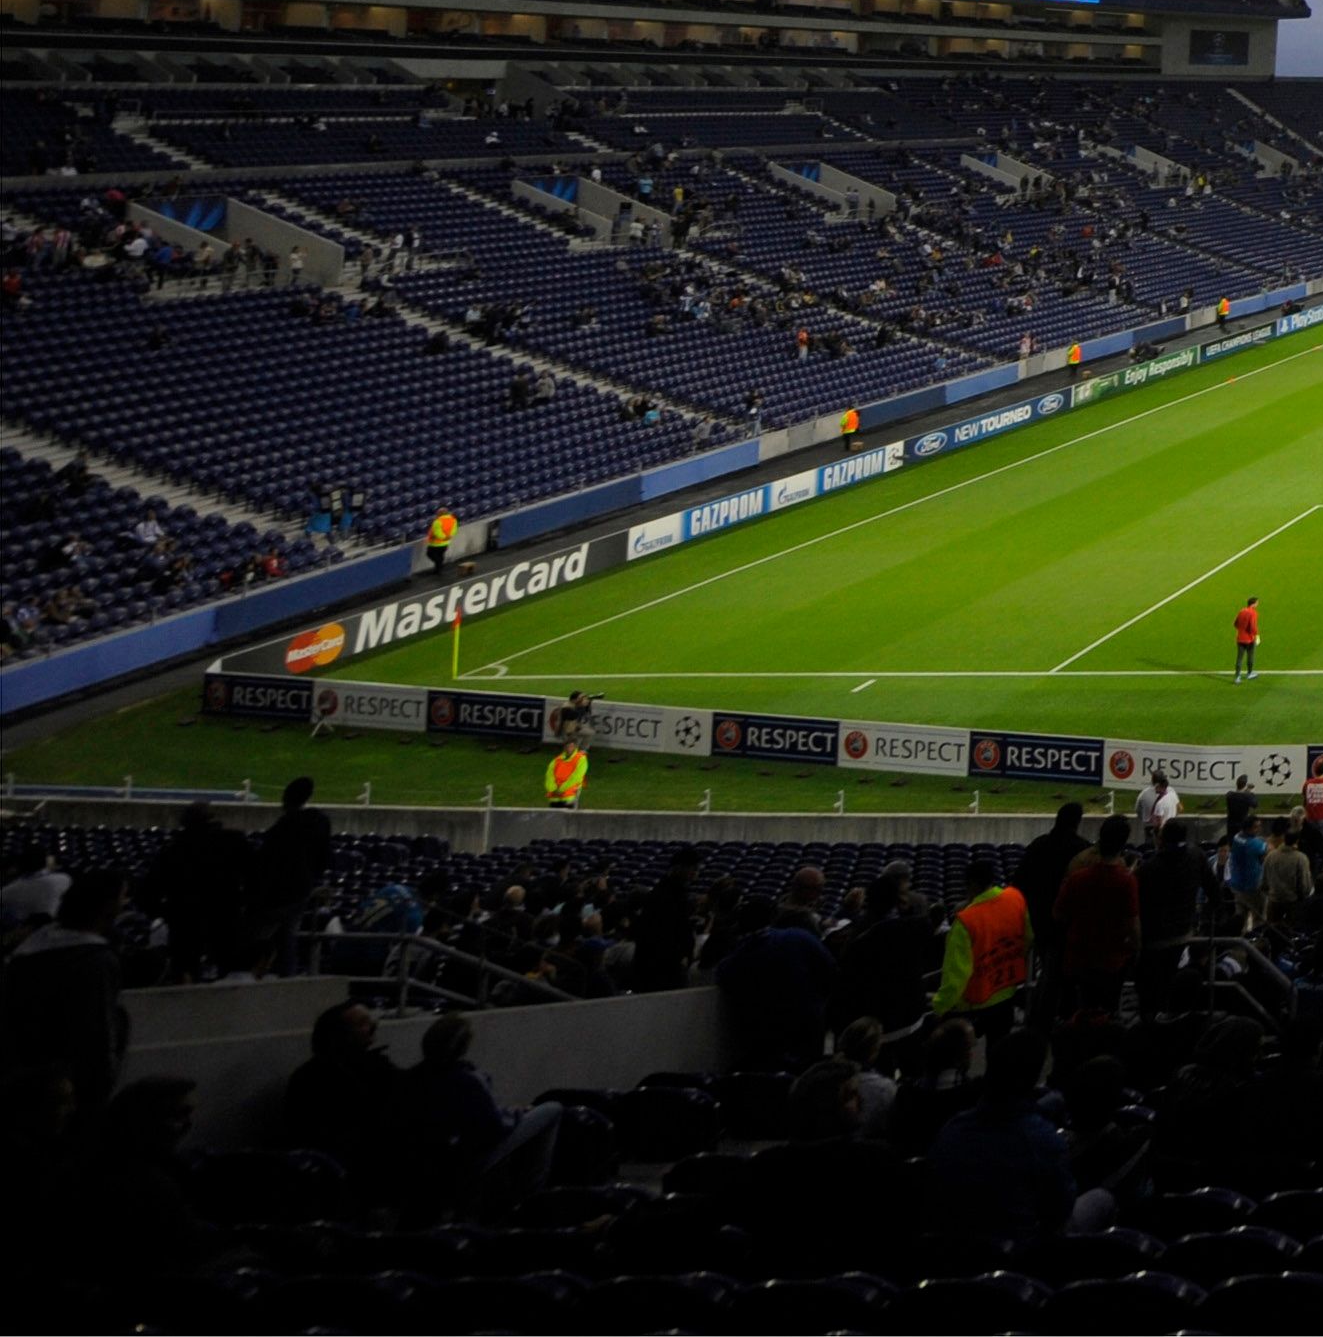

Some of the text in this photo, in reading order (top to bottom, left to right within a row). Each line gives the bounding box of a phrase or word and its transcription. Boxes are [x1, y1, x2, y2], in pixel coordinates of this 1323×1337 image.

[1124, 365, 1149, 386] Enjoy
[955, 405, 1032, 443] NEW TOURNEO
[823, 450, 884, 491] GAZPROM
[690, 488, 764, 537] GAZPROM
[354, 543, 589, 654] MasterCard
[232, 686, 311, 710] RESPECT
[345, 695, 424, 719] RESPECT
[459, 704, 542, 728] RESPECT
[747, 726, 836, 753] RESPECT
[875, 737, 966, 763] RESPECT
[1007, 745, 1100, 772] RESPECT
